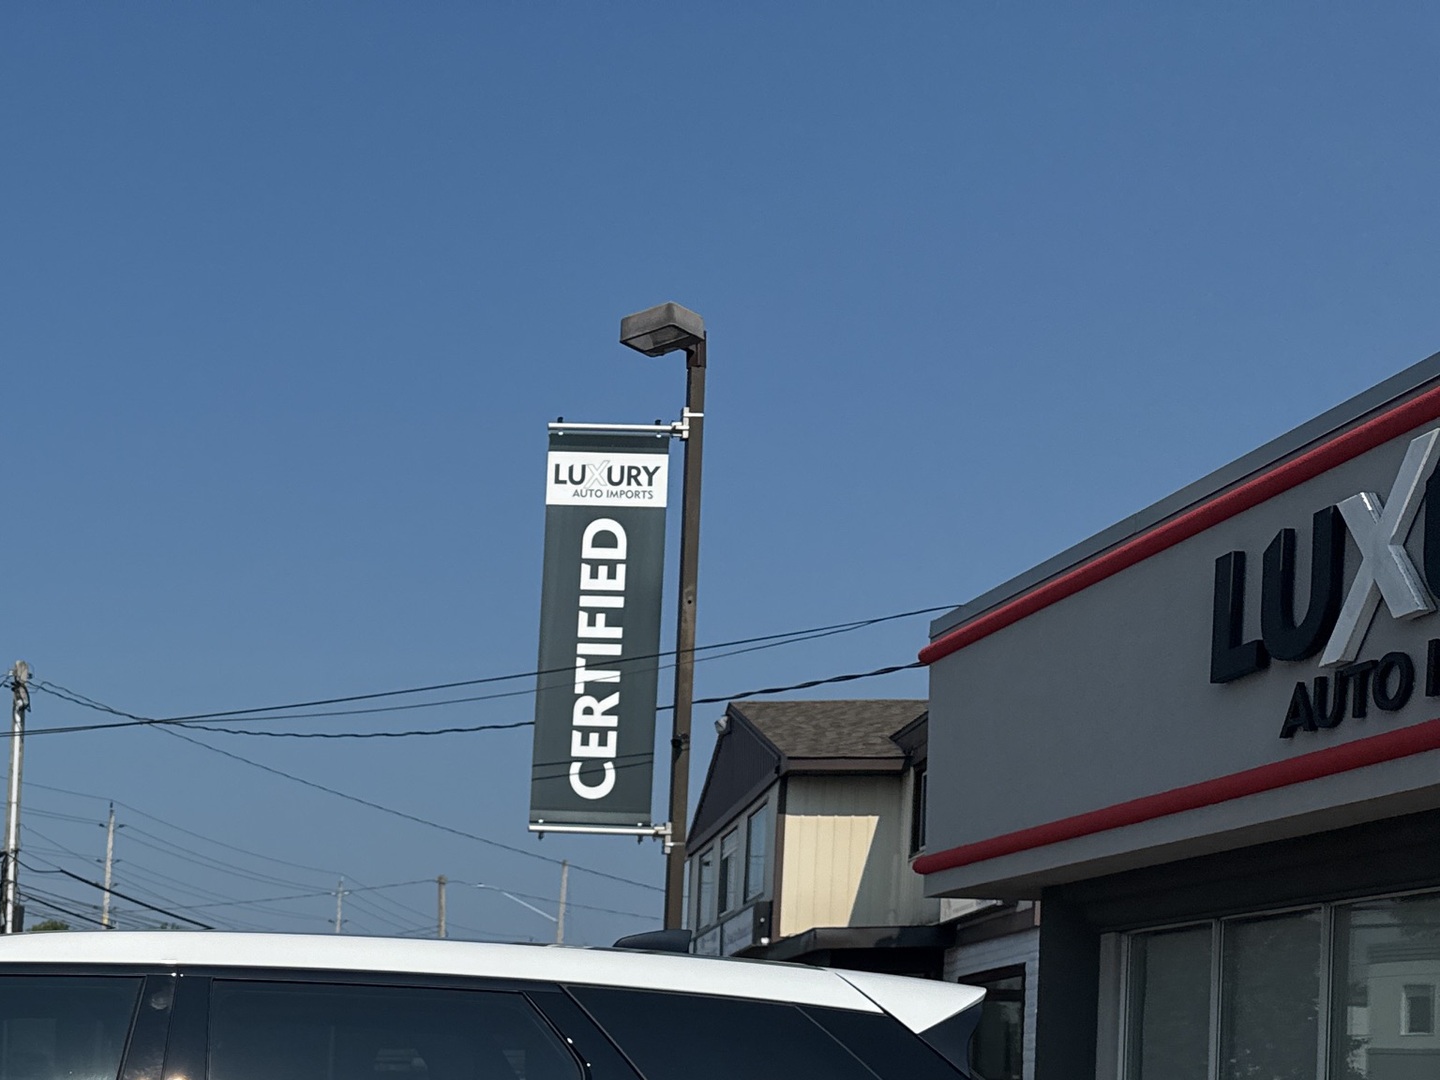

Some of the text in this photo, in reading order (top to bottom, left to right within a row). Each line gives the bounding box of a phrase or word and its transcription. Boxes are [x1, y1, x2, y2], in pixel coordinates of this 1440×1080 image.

[554, 459, 661, 489] LUXURY
[572, 489, 653, 500] AUTO IMPORTS
[1210, 427, 1440, 685] LUX
[569, 518, 627, 800] CERTIFIED
[1279, 651, 1416, 739] AUTO
